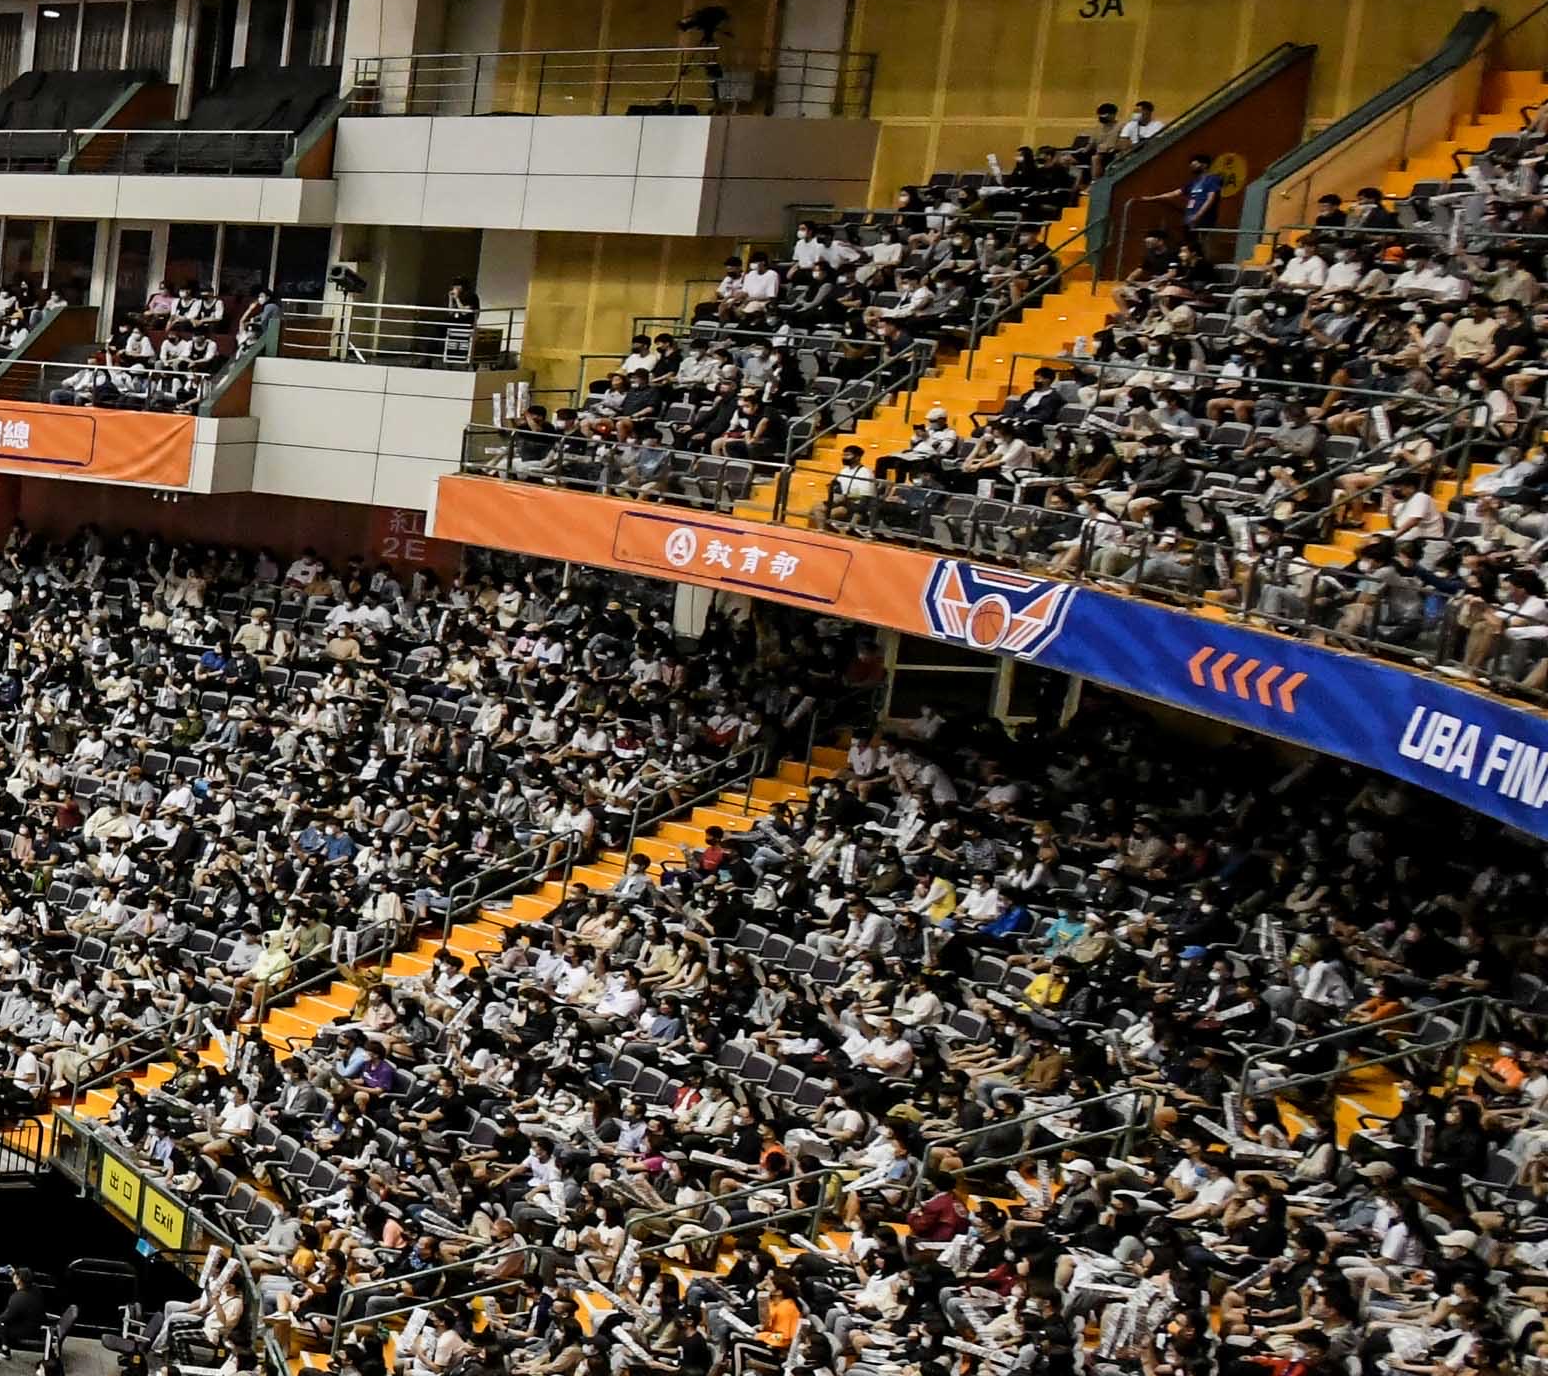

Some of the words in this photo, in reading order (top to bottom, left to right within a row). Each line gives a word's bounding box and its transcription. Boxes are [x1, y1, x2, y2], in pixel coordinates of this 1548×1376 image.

[381, 538, 428, 562] 2E
[701, 539, 801, 581] 教育部
[1398, 706, 1482, 780] UBA
[109, 1172, 134, 1202] 出口
[153, 1204, 174, 1233] Exit
